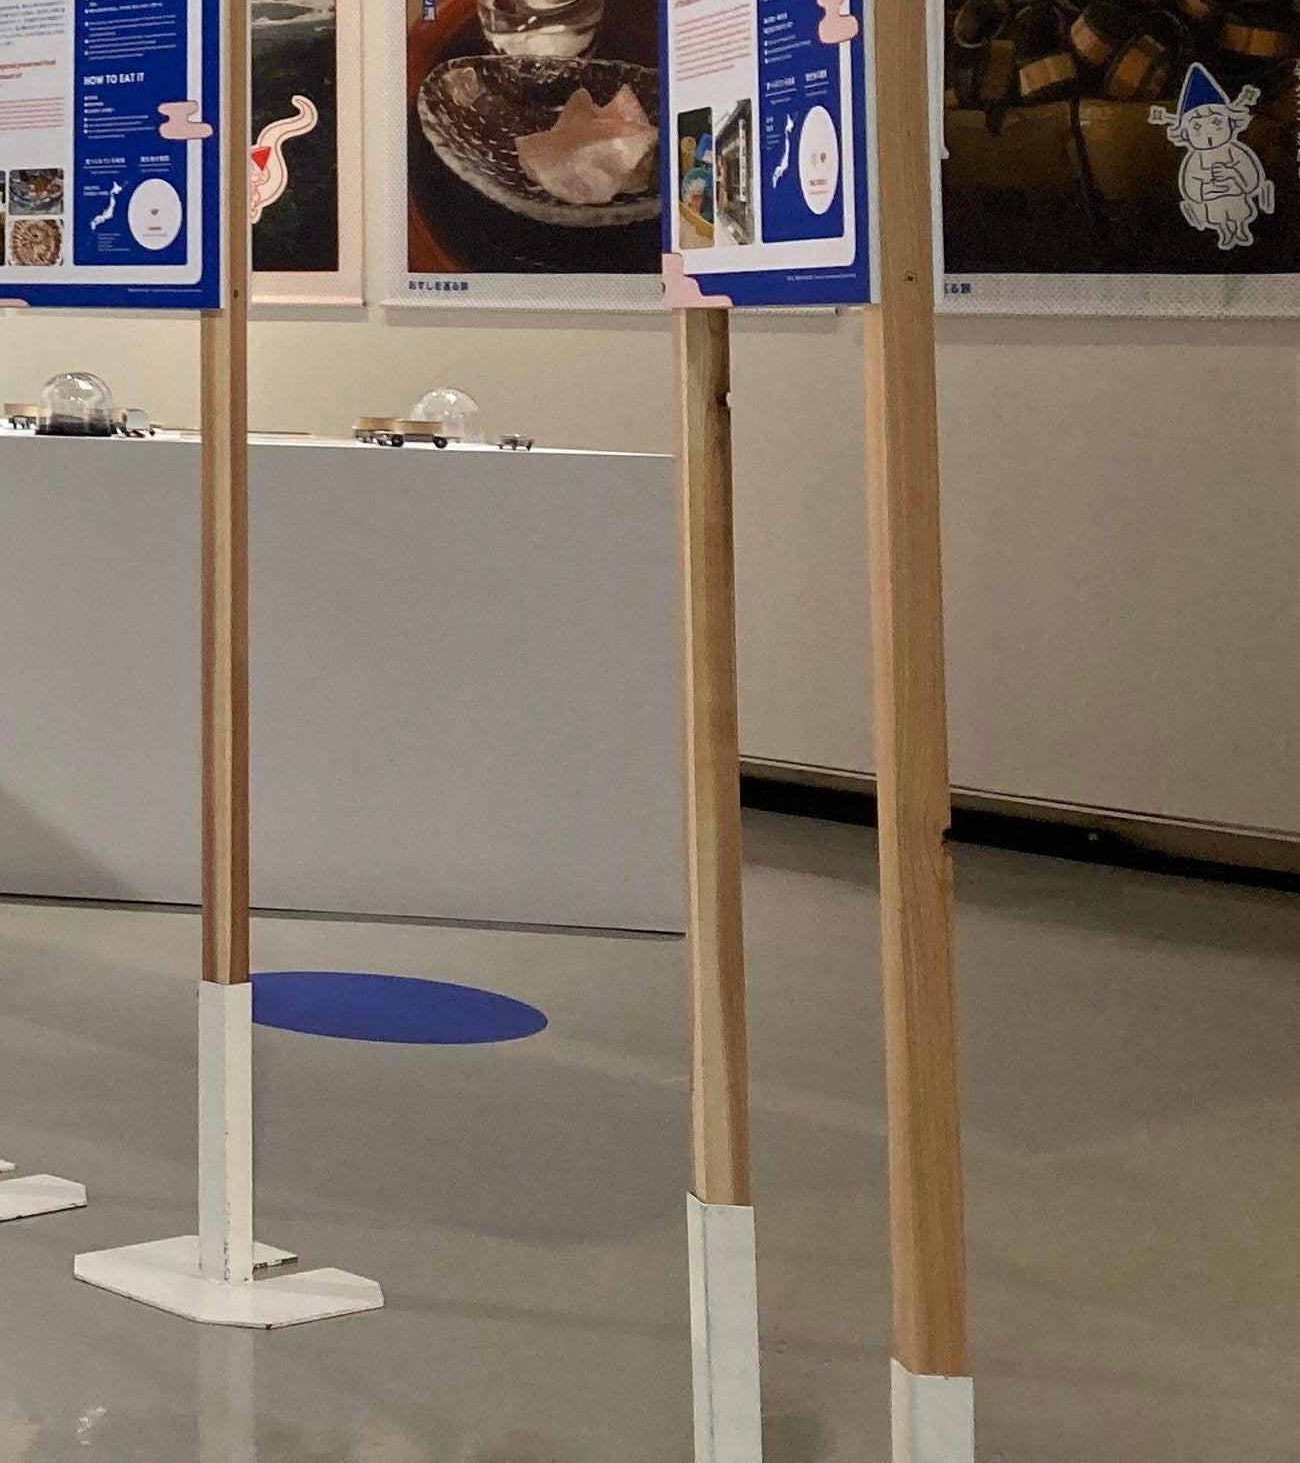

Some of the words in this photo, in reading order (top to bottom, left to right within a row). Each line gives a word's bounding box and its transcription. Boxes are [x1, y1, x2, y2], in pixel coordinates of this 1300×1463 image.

[83, 76, 105, 85] HOW
[106, 74, 118, 84] TO
[119, 73, 136, 83] EAT
[137, 72, 145, 82] IT
